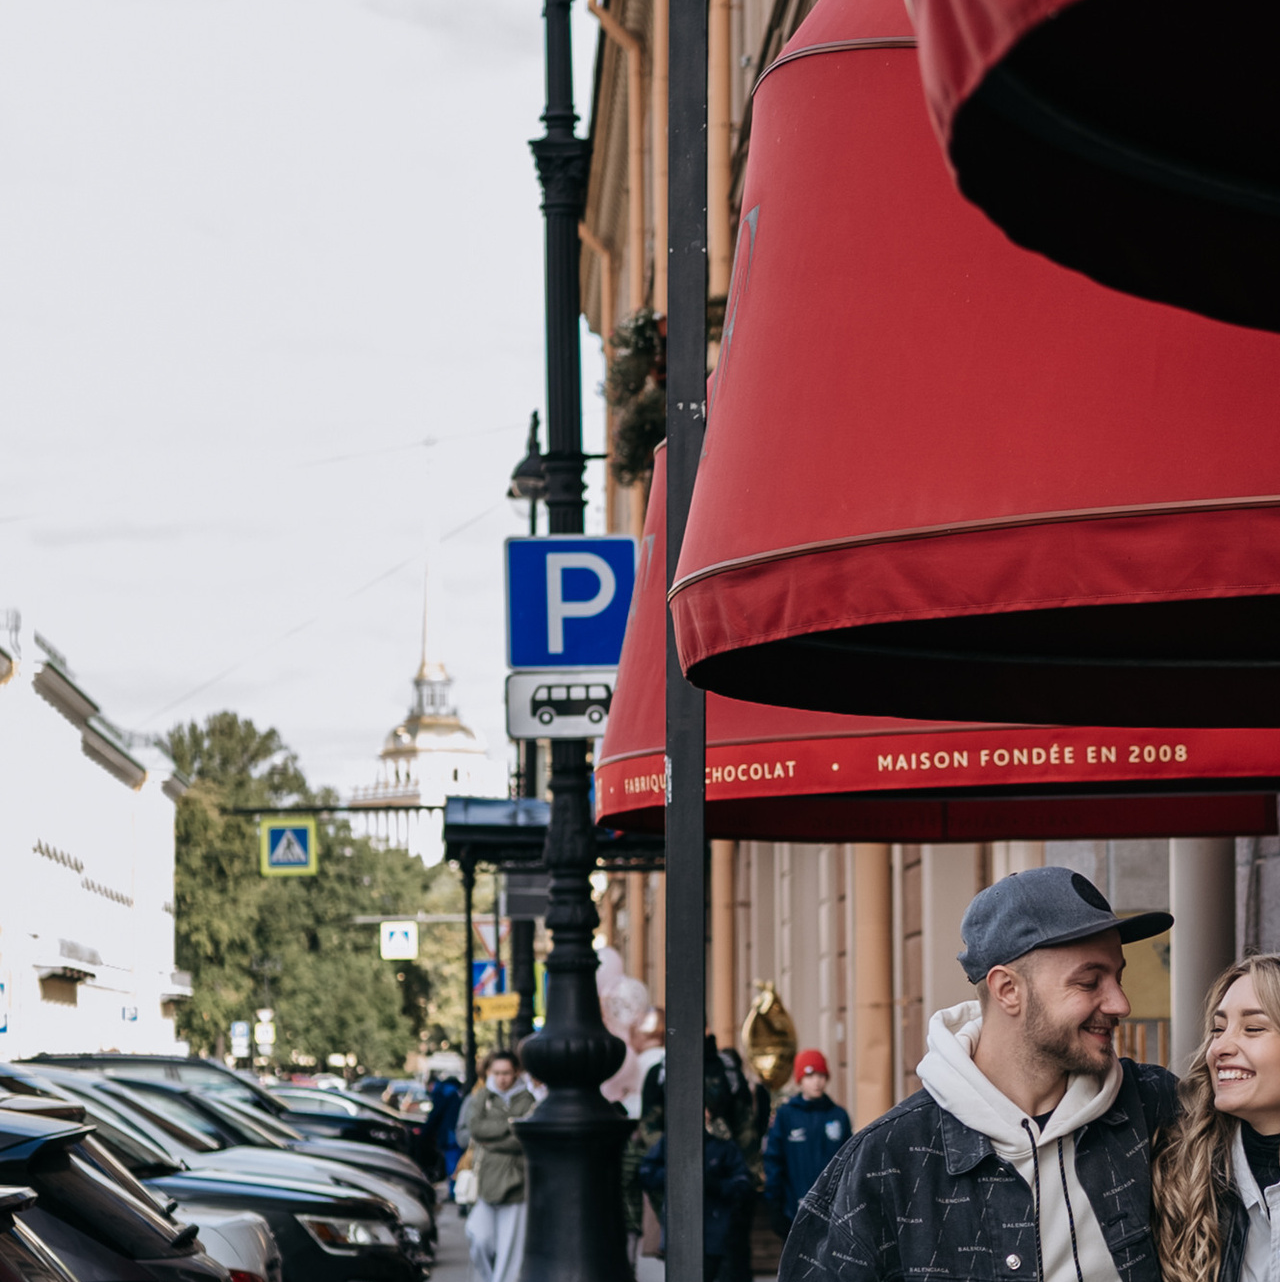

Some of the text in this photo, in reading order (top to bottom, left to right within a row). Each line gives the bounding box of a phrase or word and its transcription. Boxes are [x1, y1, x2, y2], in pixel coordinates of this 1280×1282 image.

[546, 552, 616, 655] P
[624, 744, 1188, 794] FABRIQU CHOCOLAT MAISON FONDÉE EN 2008
